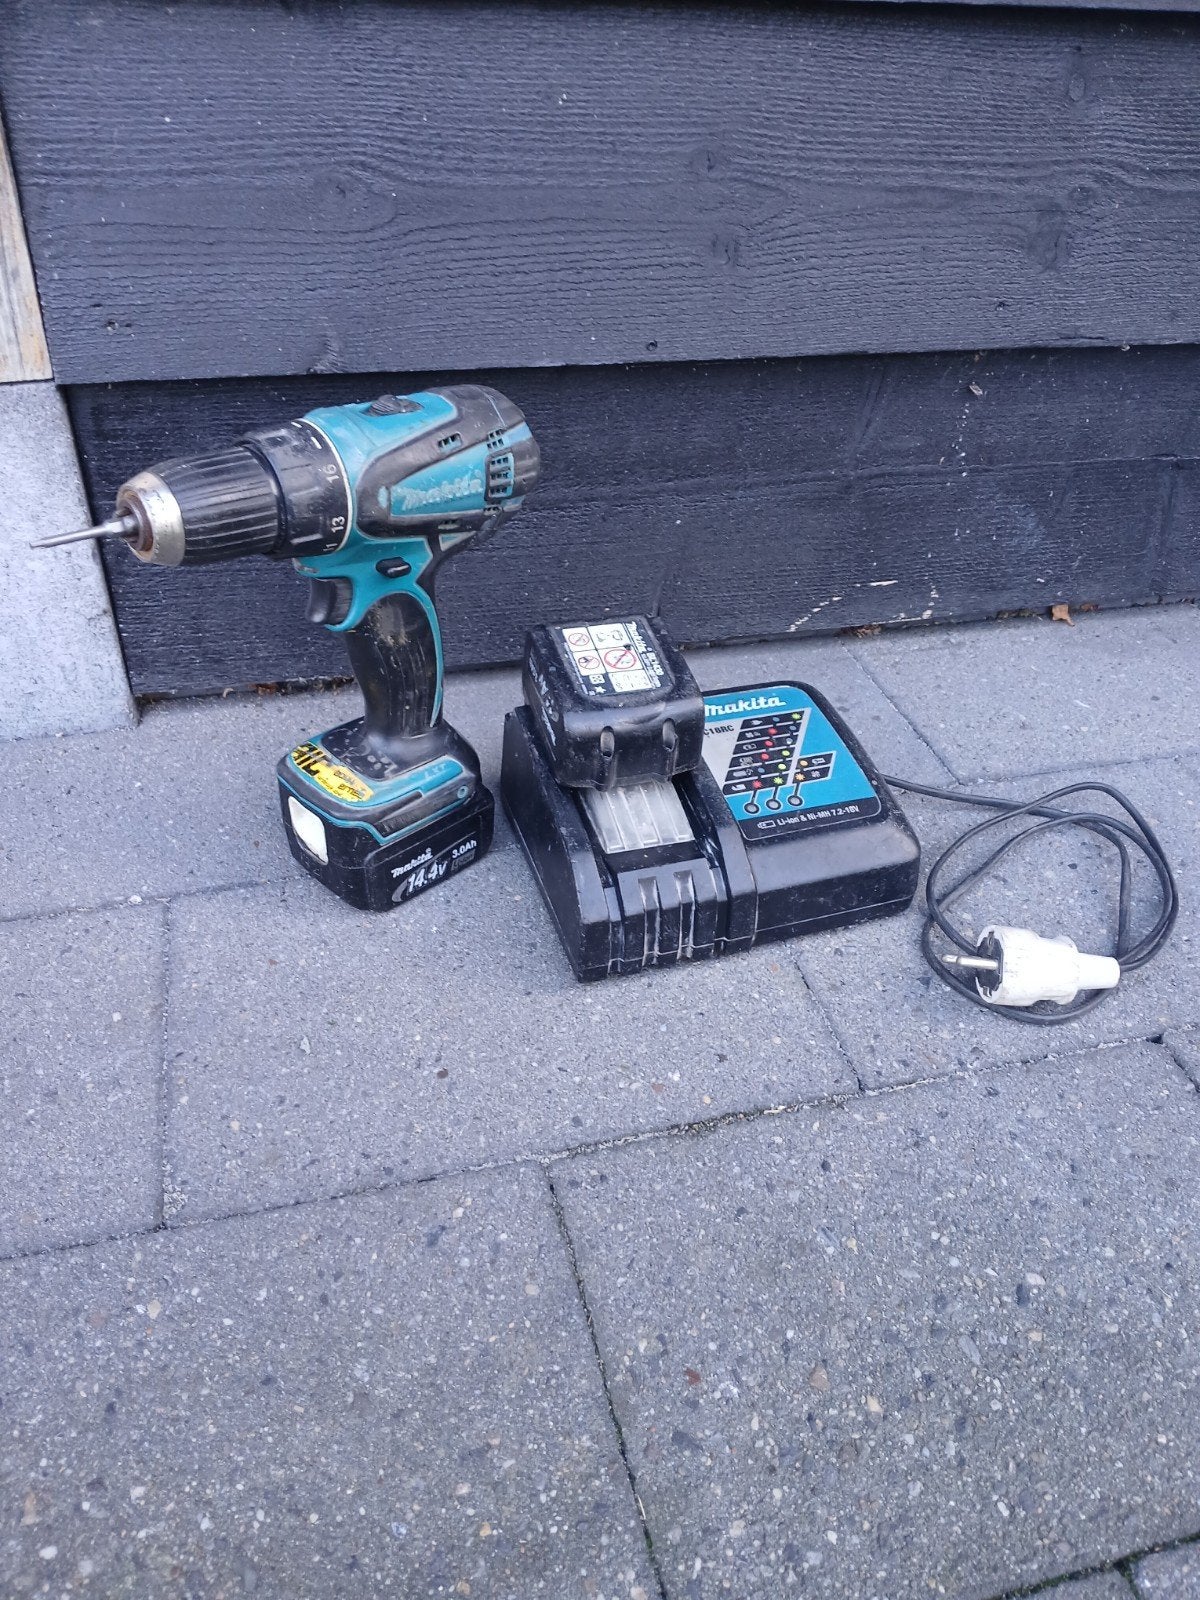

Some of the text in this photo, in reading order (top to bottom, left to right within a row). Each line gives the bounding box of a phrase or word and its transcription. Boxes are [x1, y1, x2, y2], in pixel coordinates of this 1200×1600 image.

[323, 463, 339, 483] 16
[331, 515, 346, 533] 13
[800, 814, 808, 822] &
[452, 840, 477, 859] 3.0Ah
